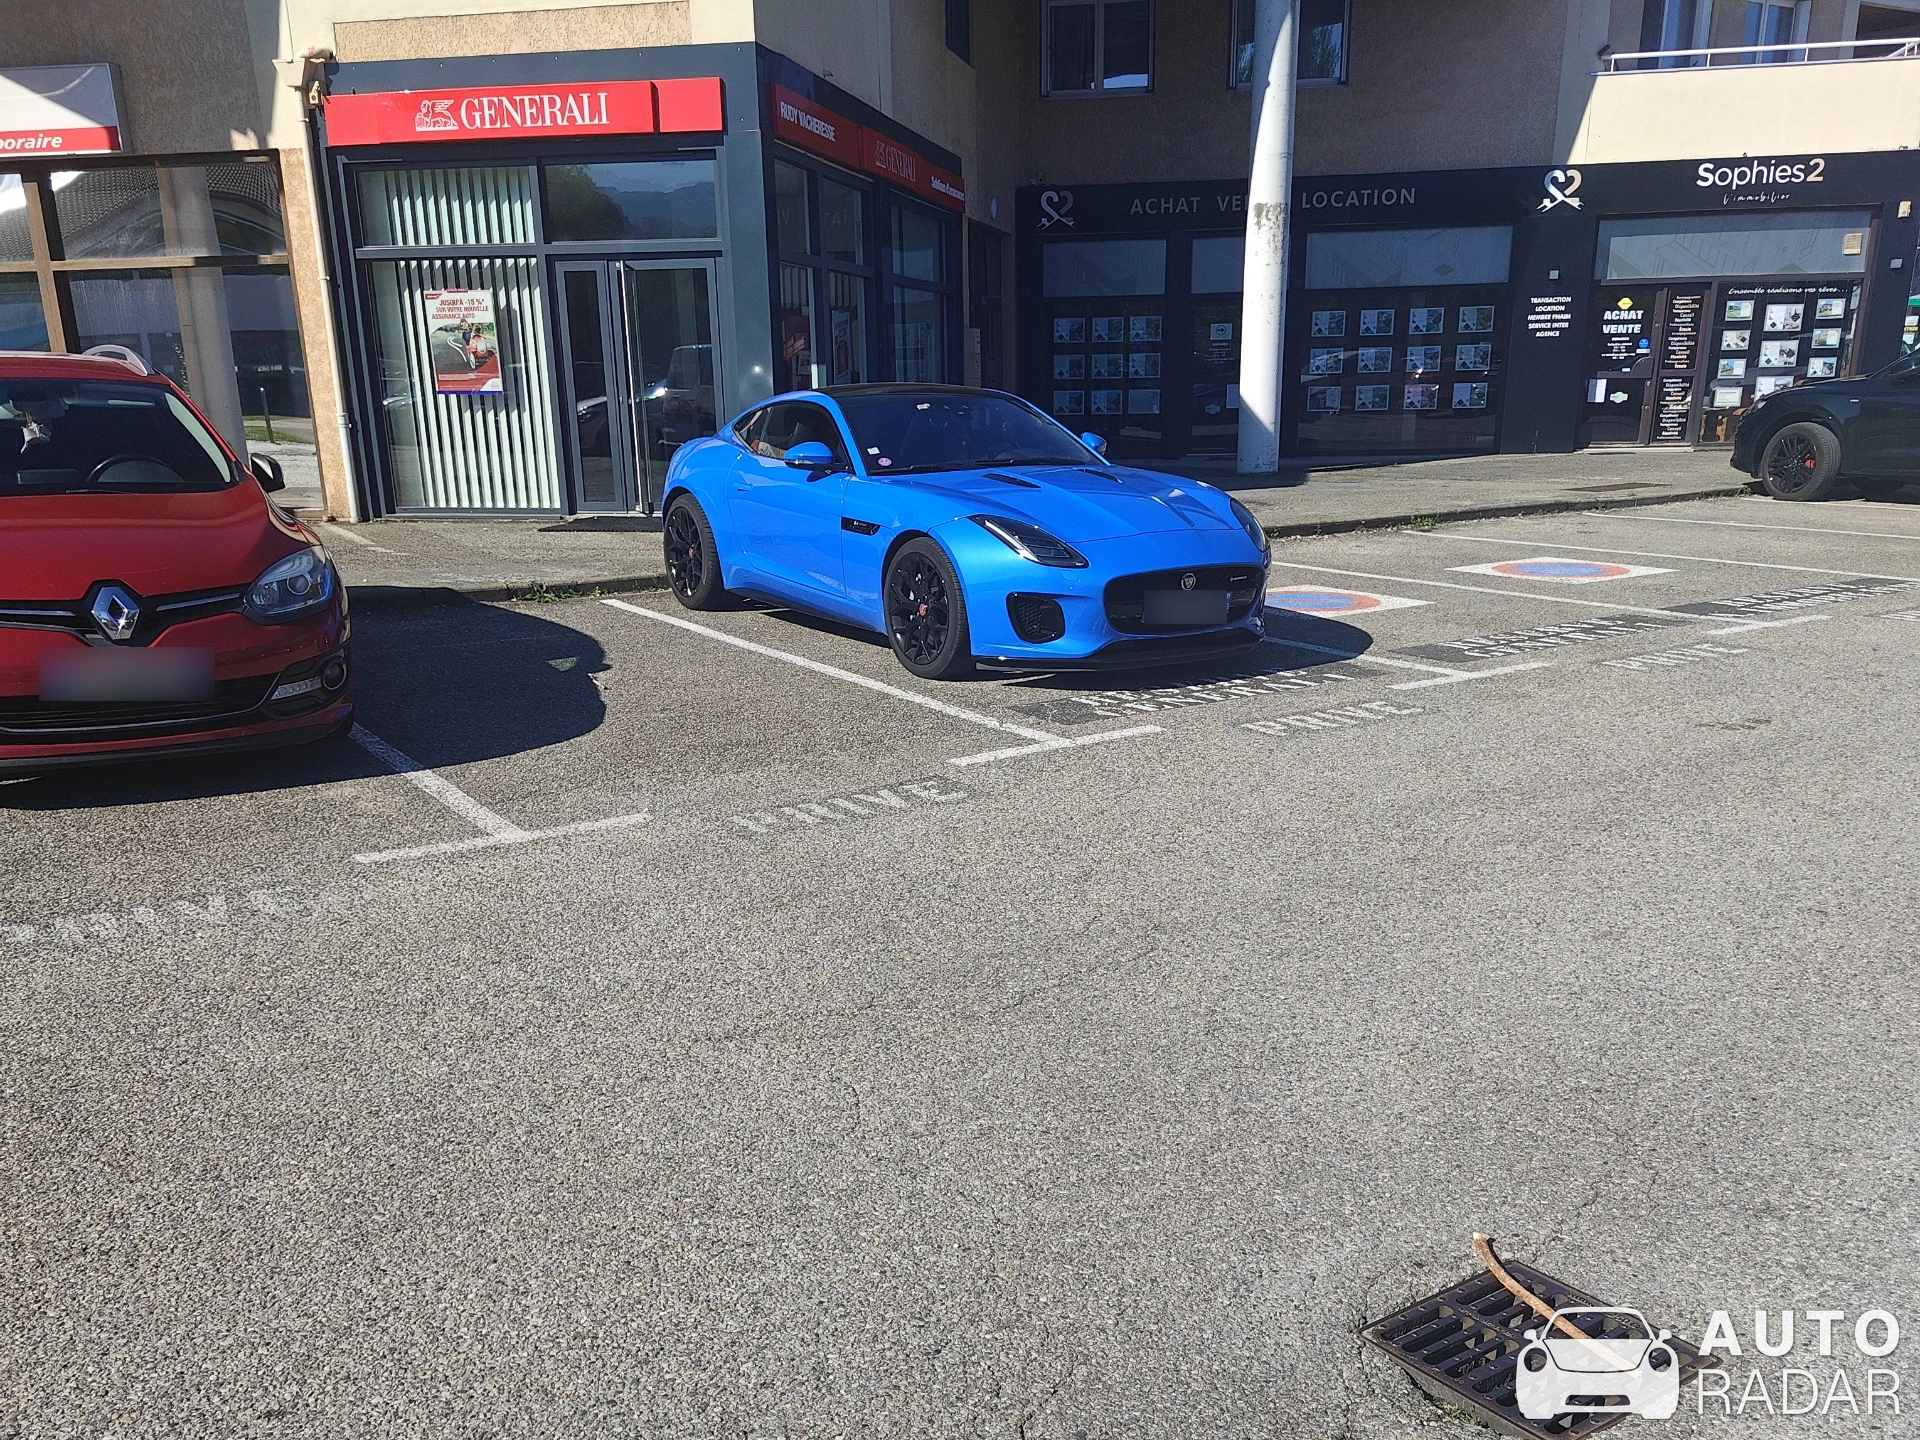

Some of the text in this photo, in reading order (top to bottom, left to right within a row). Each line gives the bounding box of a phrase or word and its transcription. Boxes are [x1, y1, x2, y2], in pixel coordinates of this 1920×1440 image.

[460, 92, 611, 129] GENERALI
[780, 101, 798, 124] RUDY
[885, 145, 916, 182] GENERALI
[1696, 157, 1826, 190] Sophies2
[1130, 197, 1201, 215] ACHAT
[1301, 187, 1417, 209] LOCATION
[439, 297, 464, 306] JUSQU'À
[1728, 286, 1765, 294] Ensemble
[1767, 285, 1803, 294] réalisons
[1603, 310, 1644, 320] ACHAT
[1602, 324, 1641, 334] VENTE
[1240, 701, 1425, 736] PRIVE
